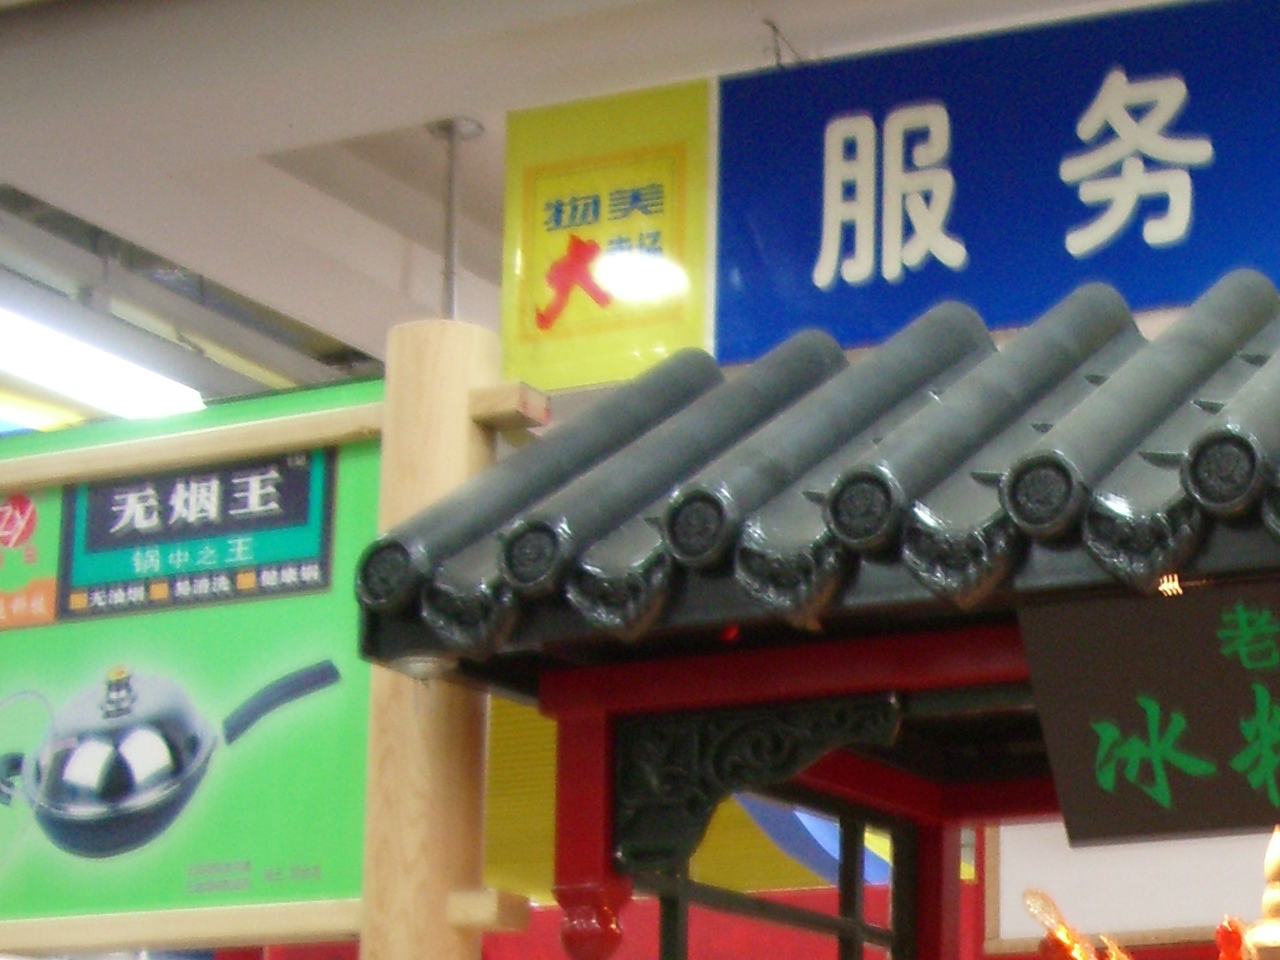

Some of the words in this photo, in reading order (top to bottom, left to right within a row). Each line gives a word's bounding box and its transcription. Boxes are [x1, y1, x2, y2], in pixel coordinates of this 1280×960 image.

[543, 183, 665, 232] 物美
[109, 470, 283, 536] 无烟王
[131, 537, 253, 575] 锅中之王
